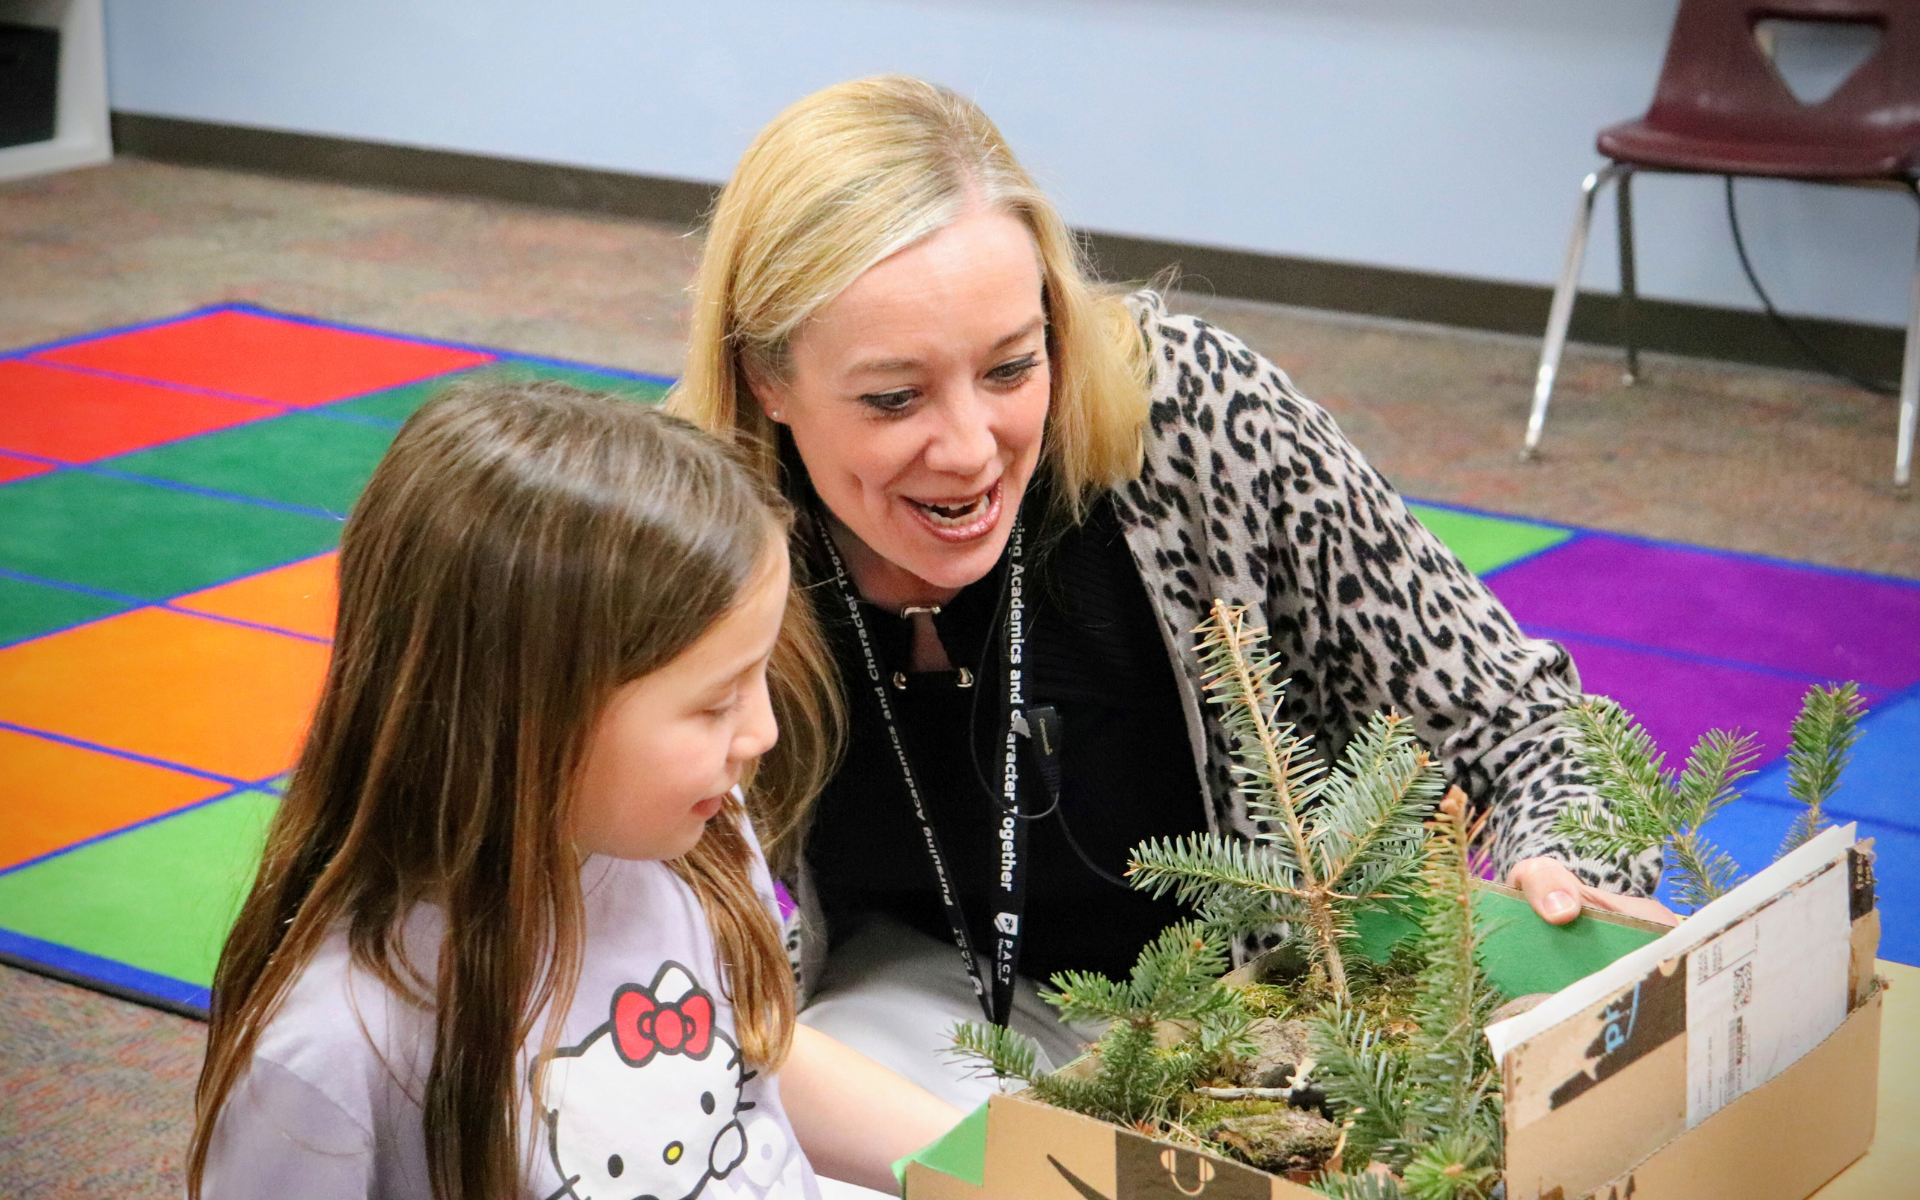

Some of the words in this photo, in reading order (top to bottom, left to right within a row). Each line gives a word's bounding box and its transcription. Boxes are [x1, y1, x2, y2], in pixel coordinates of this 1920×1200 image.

[844, 593, 881, 683] Character
[1009, 562, 1026, 666] Academics
[874, 686, 893, 721] and
[1009, 670, 1025, 705] and
[889, 725, 926, 822] Academics
[1003, 709, 1023, 802] Caracter
[923, 825, 954, 907] Pursuing
[1001, 939, 1015, 987] PACT
